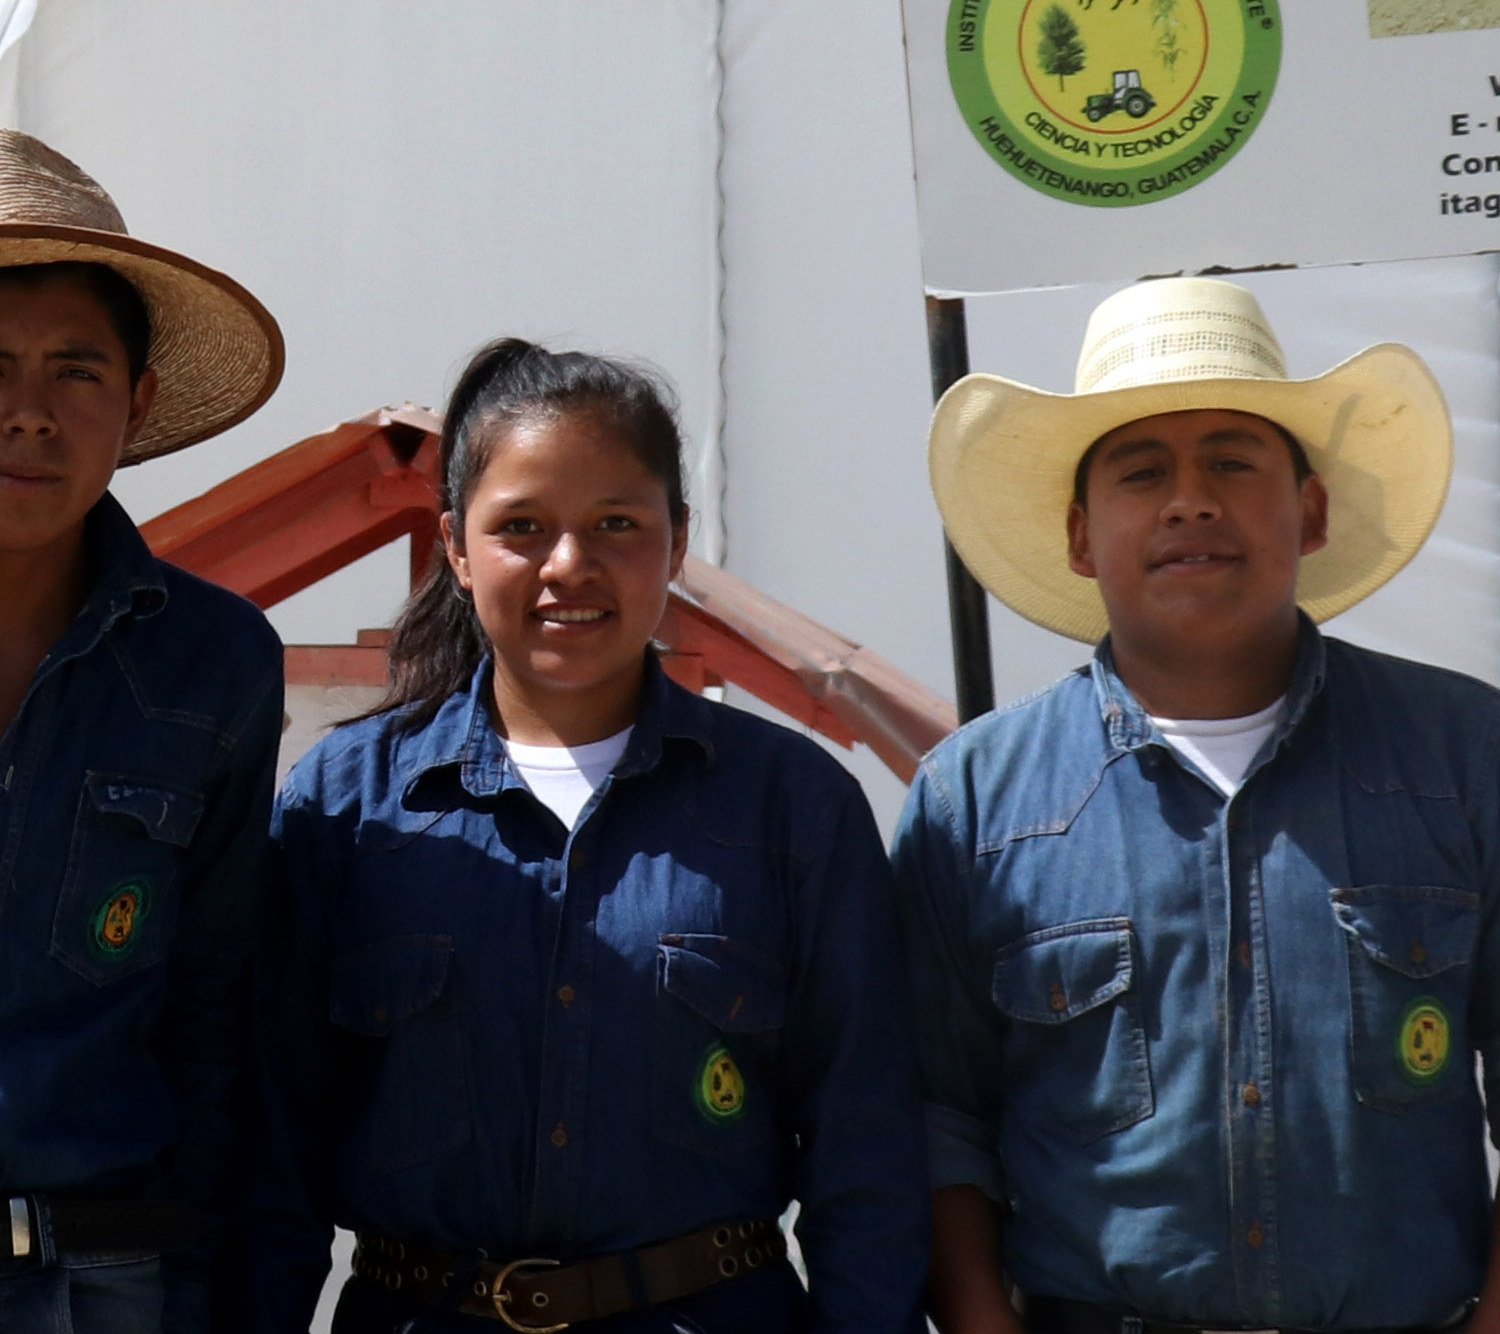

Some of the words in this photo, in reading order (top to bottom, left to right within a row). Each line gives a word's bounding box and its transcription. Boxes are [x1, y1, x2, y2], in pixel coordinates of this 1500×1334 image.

[1025, 112, 1090, 155] CIENCIA
[1094, 142, 1108, 158] Y
[1110, 94, 1220, 158] TECNOLOGÍA
[1451, 113, 1469, 136] E
[979, 116, 1134, 198] HUEHUETENANGO,
[1137, 126, 1242, 194] GUATEMALA
